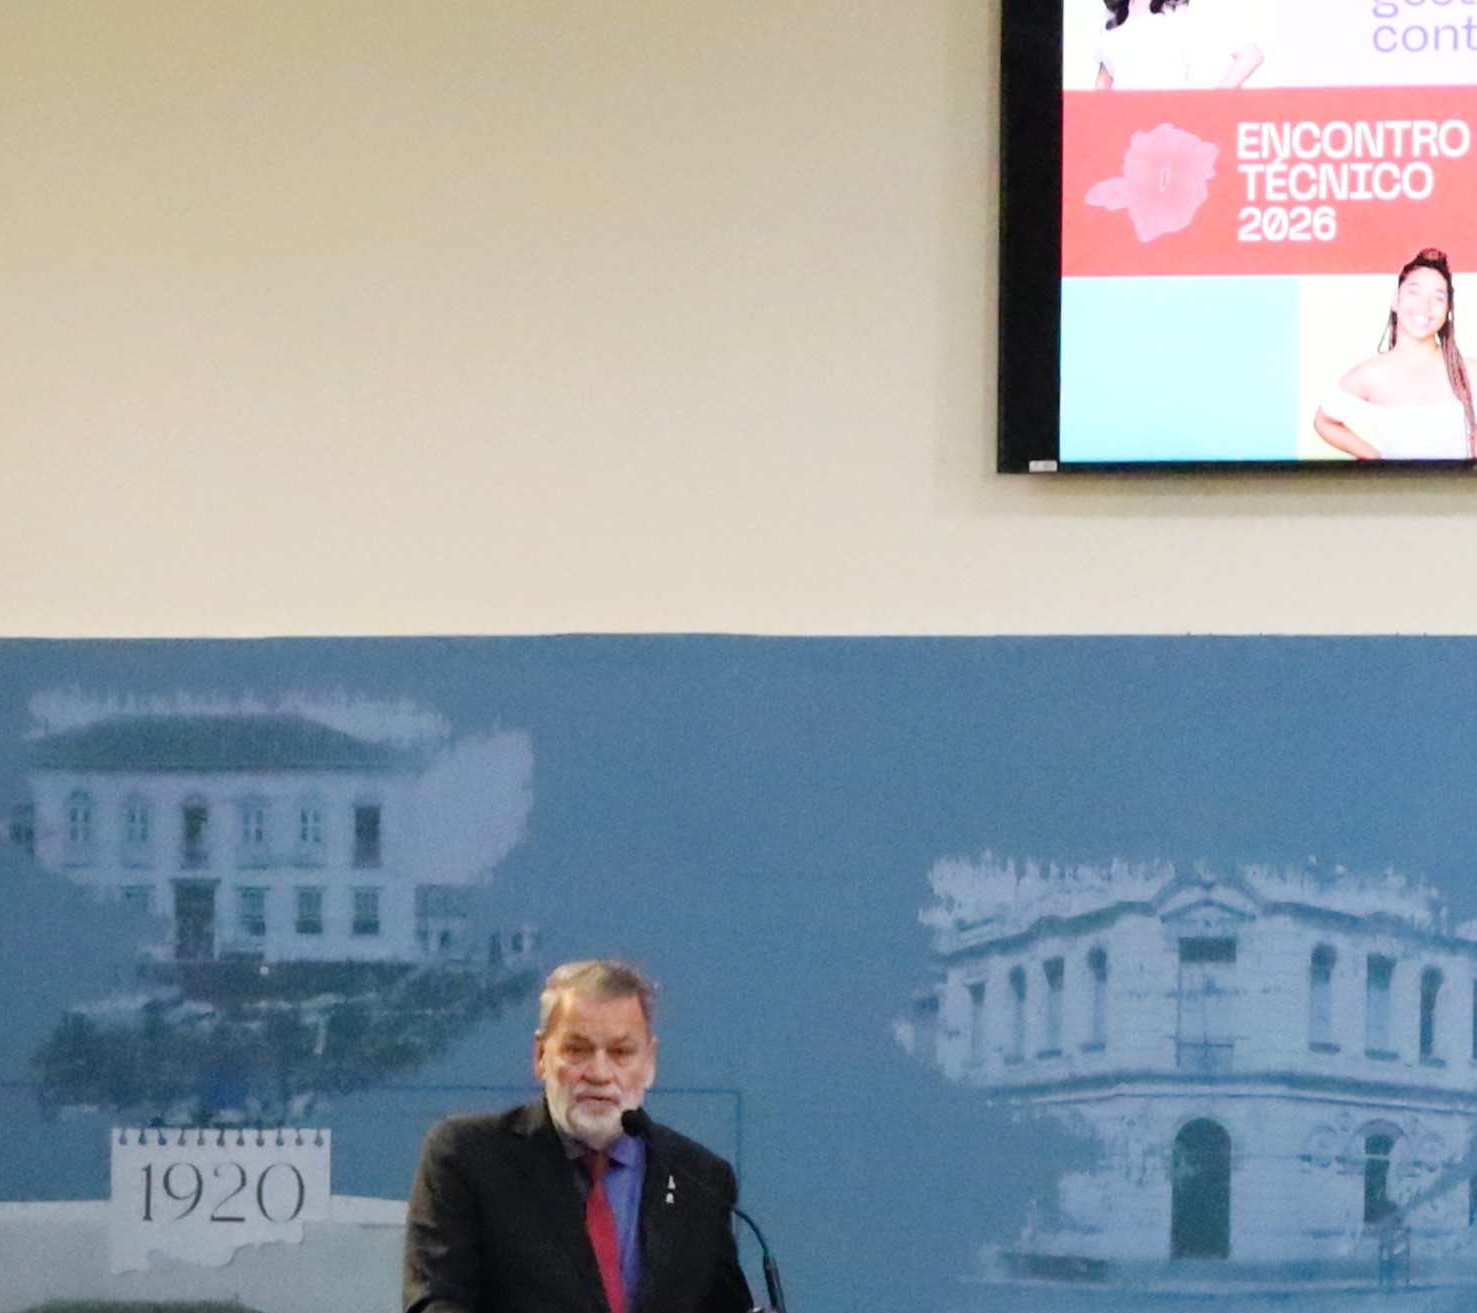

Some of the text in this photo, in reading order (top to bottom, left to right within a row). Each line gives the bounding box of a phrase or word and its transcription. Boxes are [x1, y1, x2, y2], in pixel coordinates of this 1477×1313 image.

[1237, 119, 1471, 159] ENCONTRO
[1237, 157, 1434, 201] TÉCNICO
[1237, 206, 1338, 242] 2026
[141, 1162, 305, 1223] 1920
